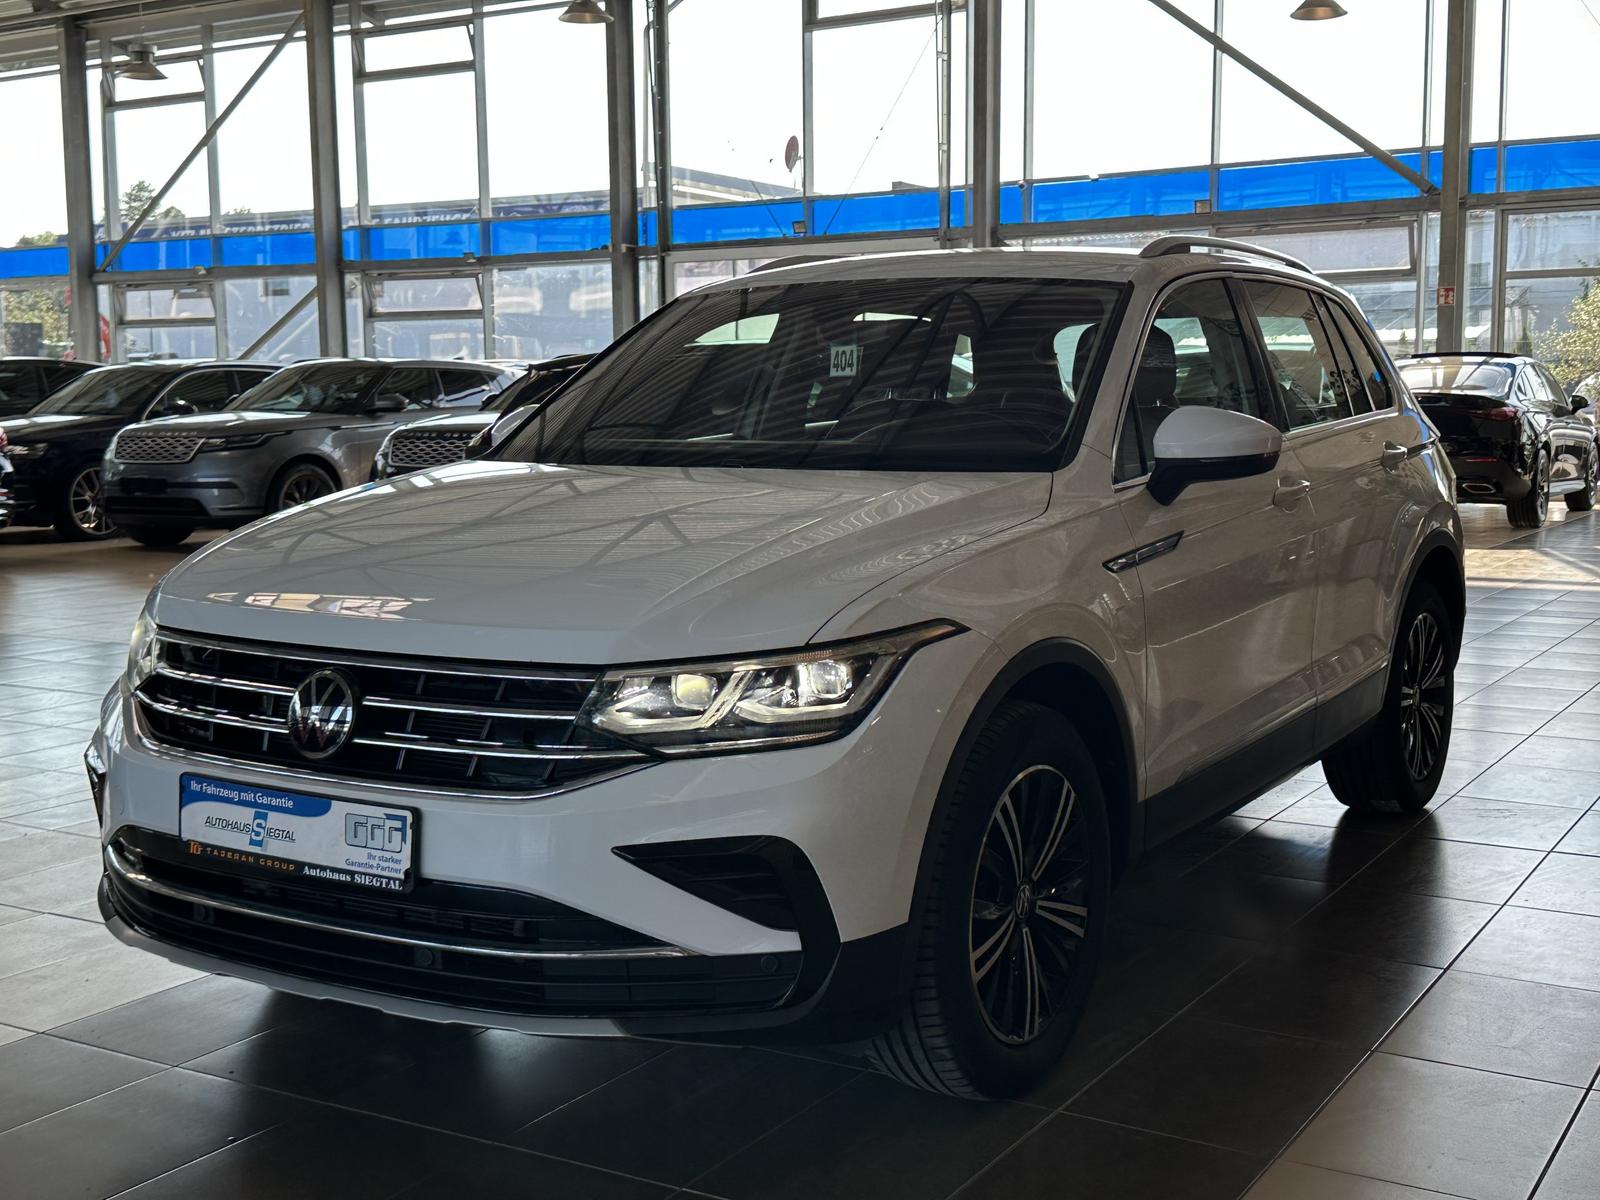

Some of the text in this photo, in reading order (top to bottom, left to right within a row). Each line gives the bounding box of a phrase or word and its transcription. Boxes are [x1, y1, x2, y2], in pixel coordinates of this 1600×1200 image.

[832, 350, 854, 372] 404
[190, 780, 294, 809] Ihr Fahrzeug mit Garantie
[204, 816, 252, 833] AUTOHAUS
[259, 858, 295, 871] GROUP
[345, 858, 402, 874] Garantie-Partner
[367, 852, 402, 865] Ihr starker
[303, 865, 403, 891] Autohaus SIEGTAL
